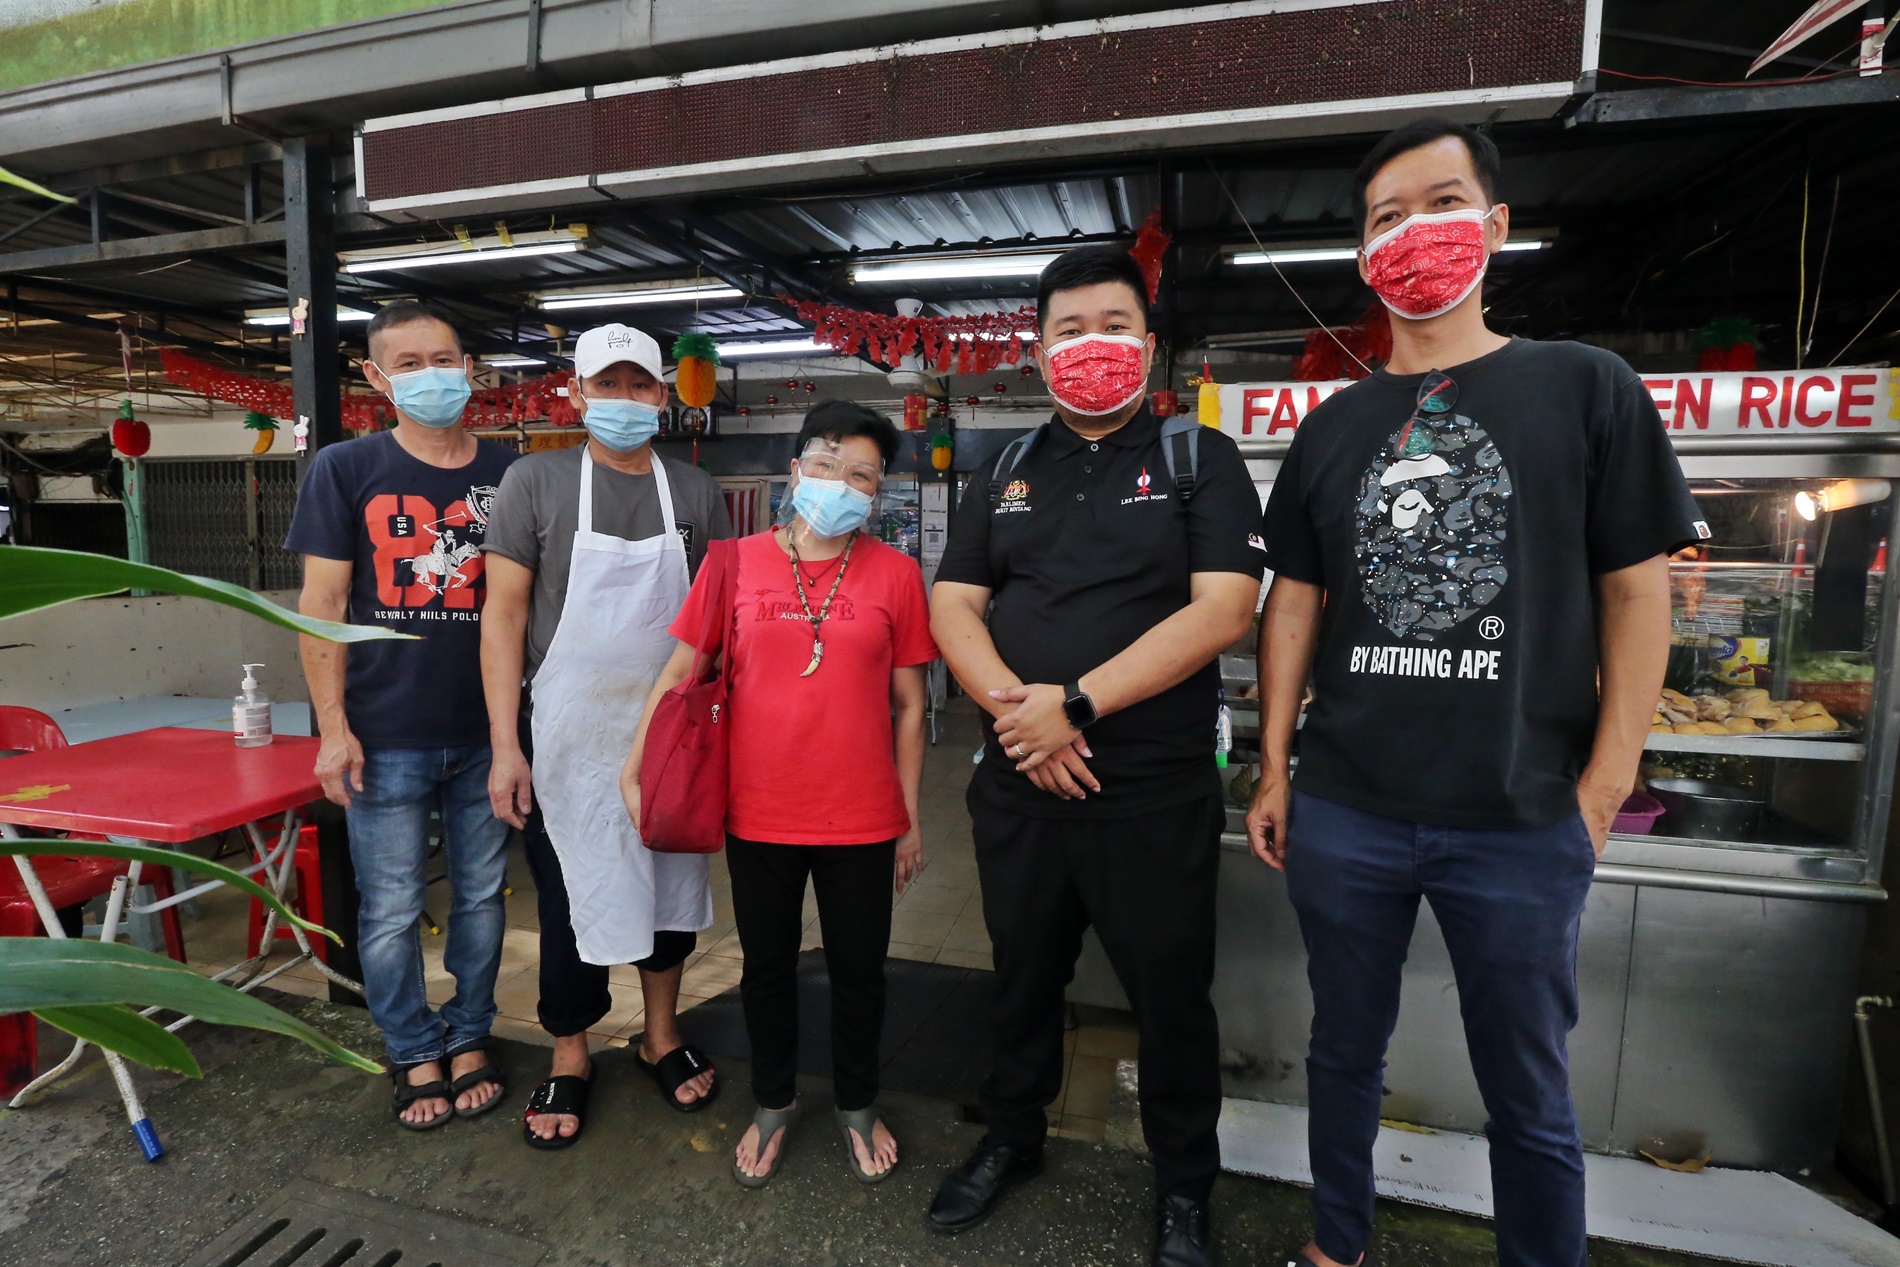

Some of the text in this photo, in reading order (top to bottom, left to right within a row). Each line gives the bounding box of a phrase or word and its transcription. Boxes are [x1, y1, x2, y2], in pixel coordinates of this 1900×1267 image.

[1642, 378, 1714, 430] EN
[1738, 374, 1877, 428] RICE
[396, 516, 408, 536] USA
[365, 494, 487, 609] 82
[452, 612, 480, 621] POLO
[1350, 646, 1501, 680] BY BATHING APE
